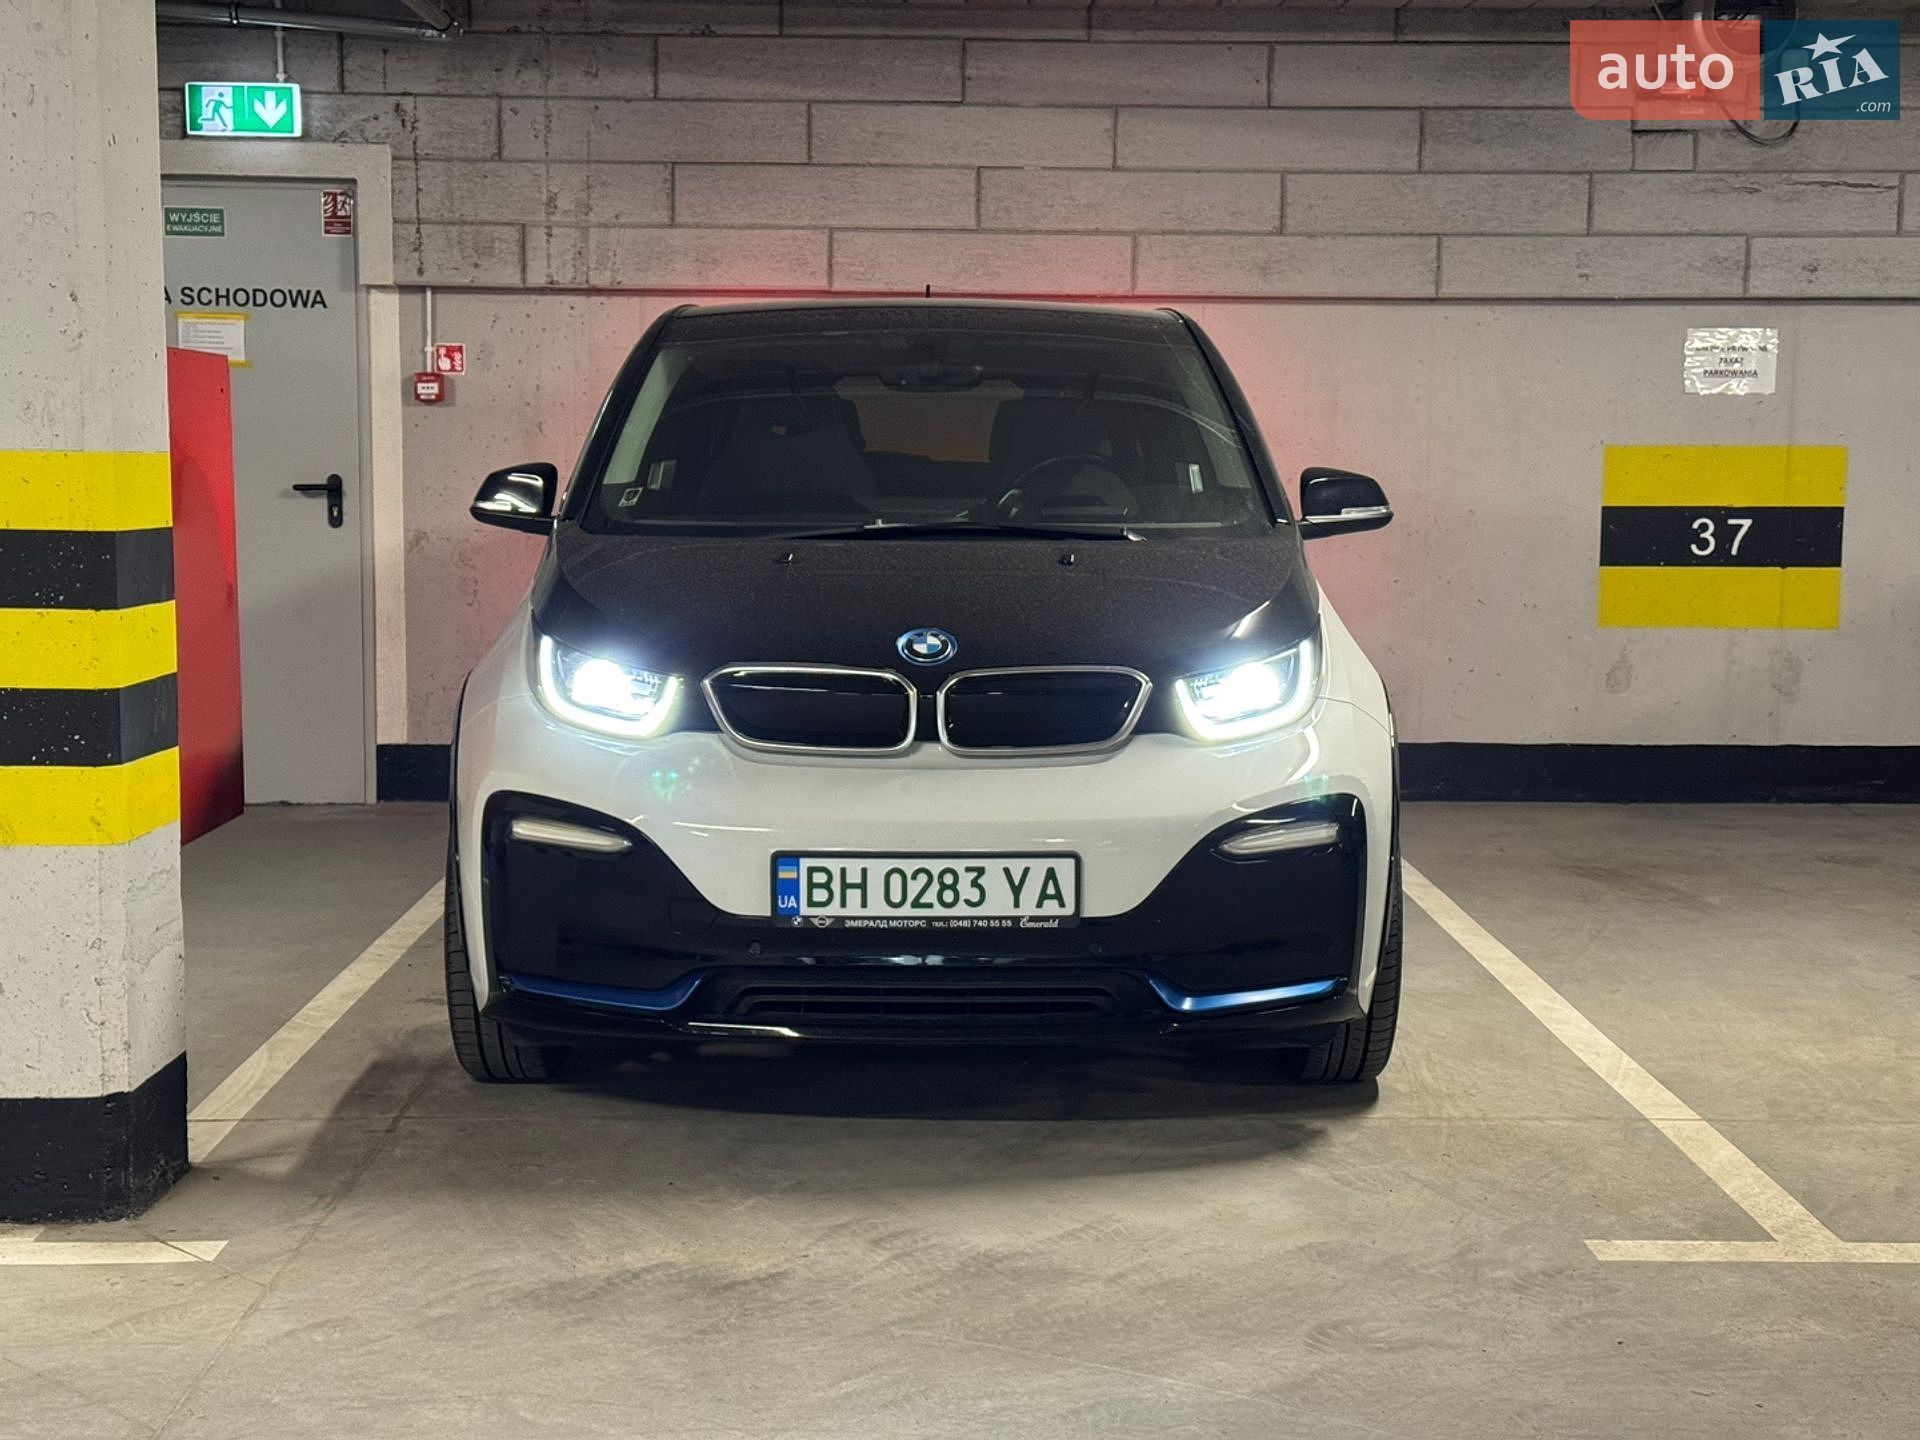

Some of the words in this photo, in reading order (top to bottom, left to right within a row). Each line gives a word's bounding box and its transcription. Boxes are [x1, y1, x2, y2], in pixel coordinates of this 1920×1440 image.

[169, 211, 220, 223] WYJŚCIE
[180, 286, 328, 309] SCHODOWA
[1690, 517, 1753, 556] 37
[806, 866, 868, 909] BH
[884, 866, 986, 909] 0283
[1002, 866, 1067, 909] YA
[778, 895, 798, 909] UA
[889, 919, 927, 928] МОТОРС
[973, 919, 988, 928] 740
